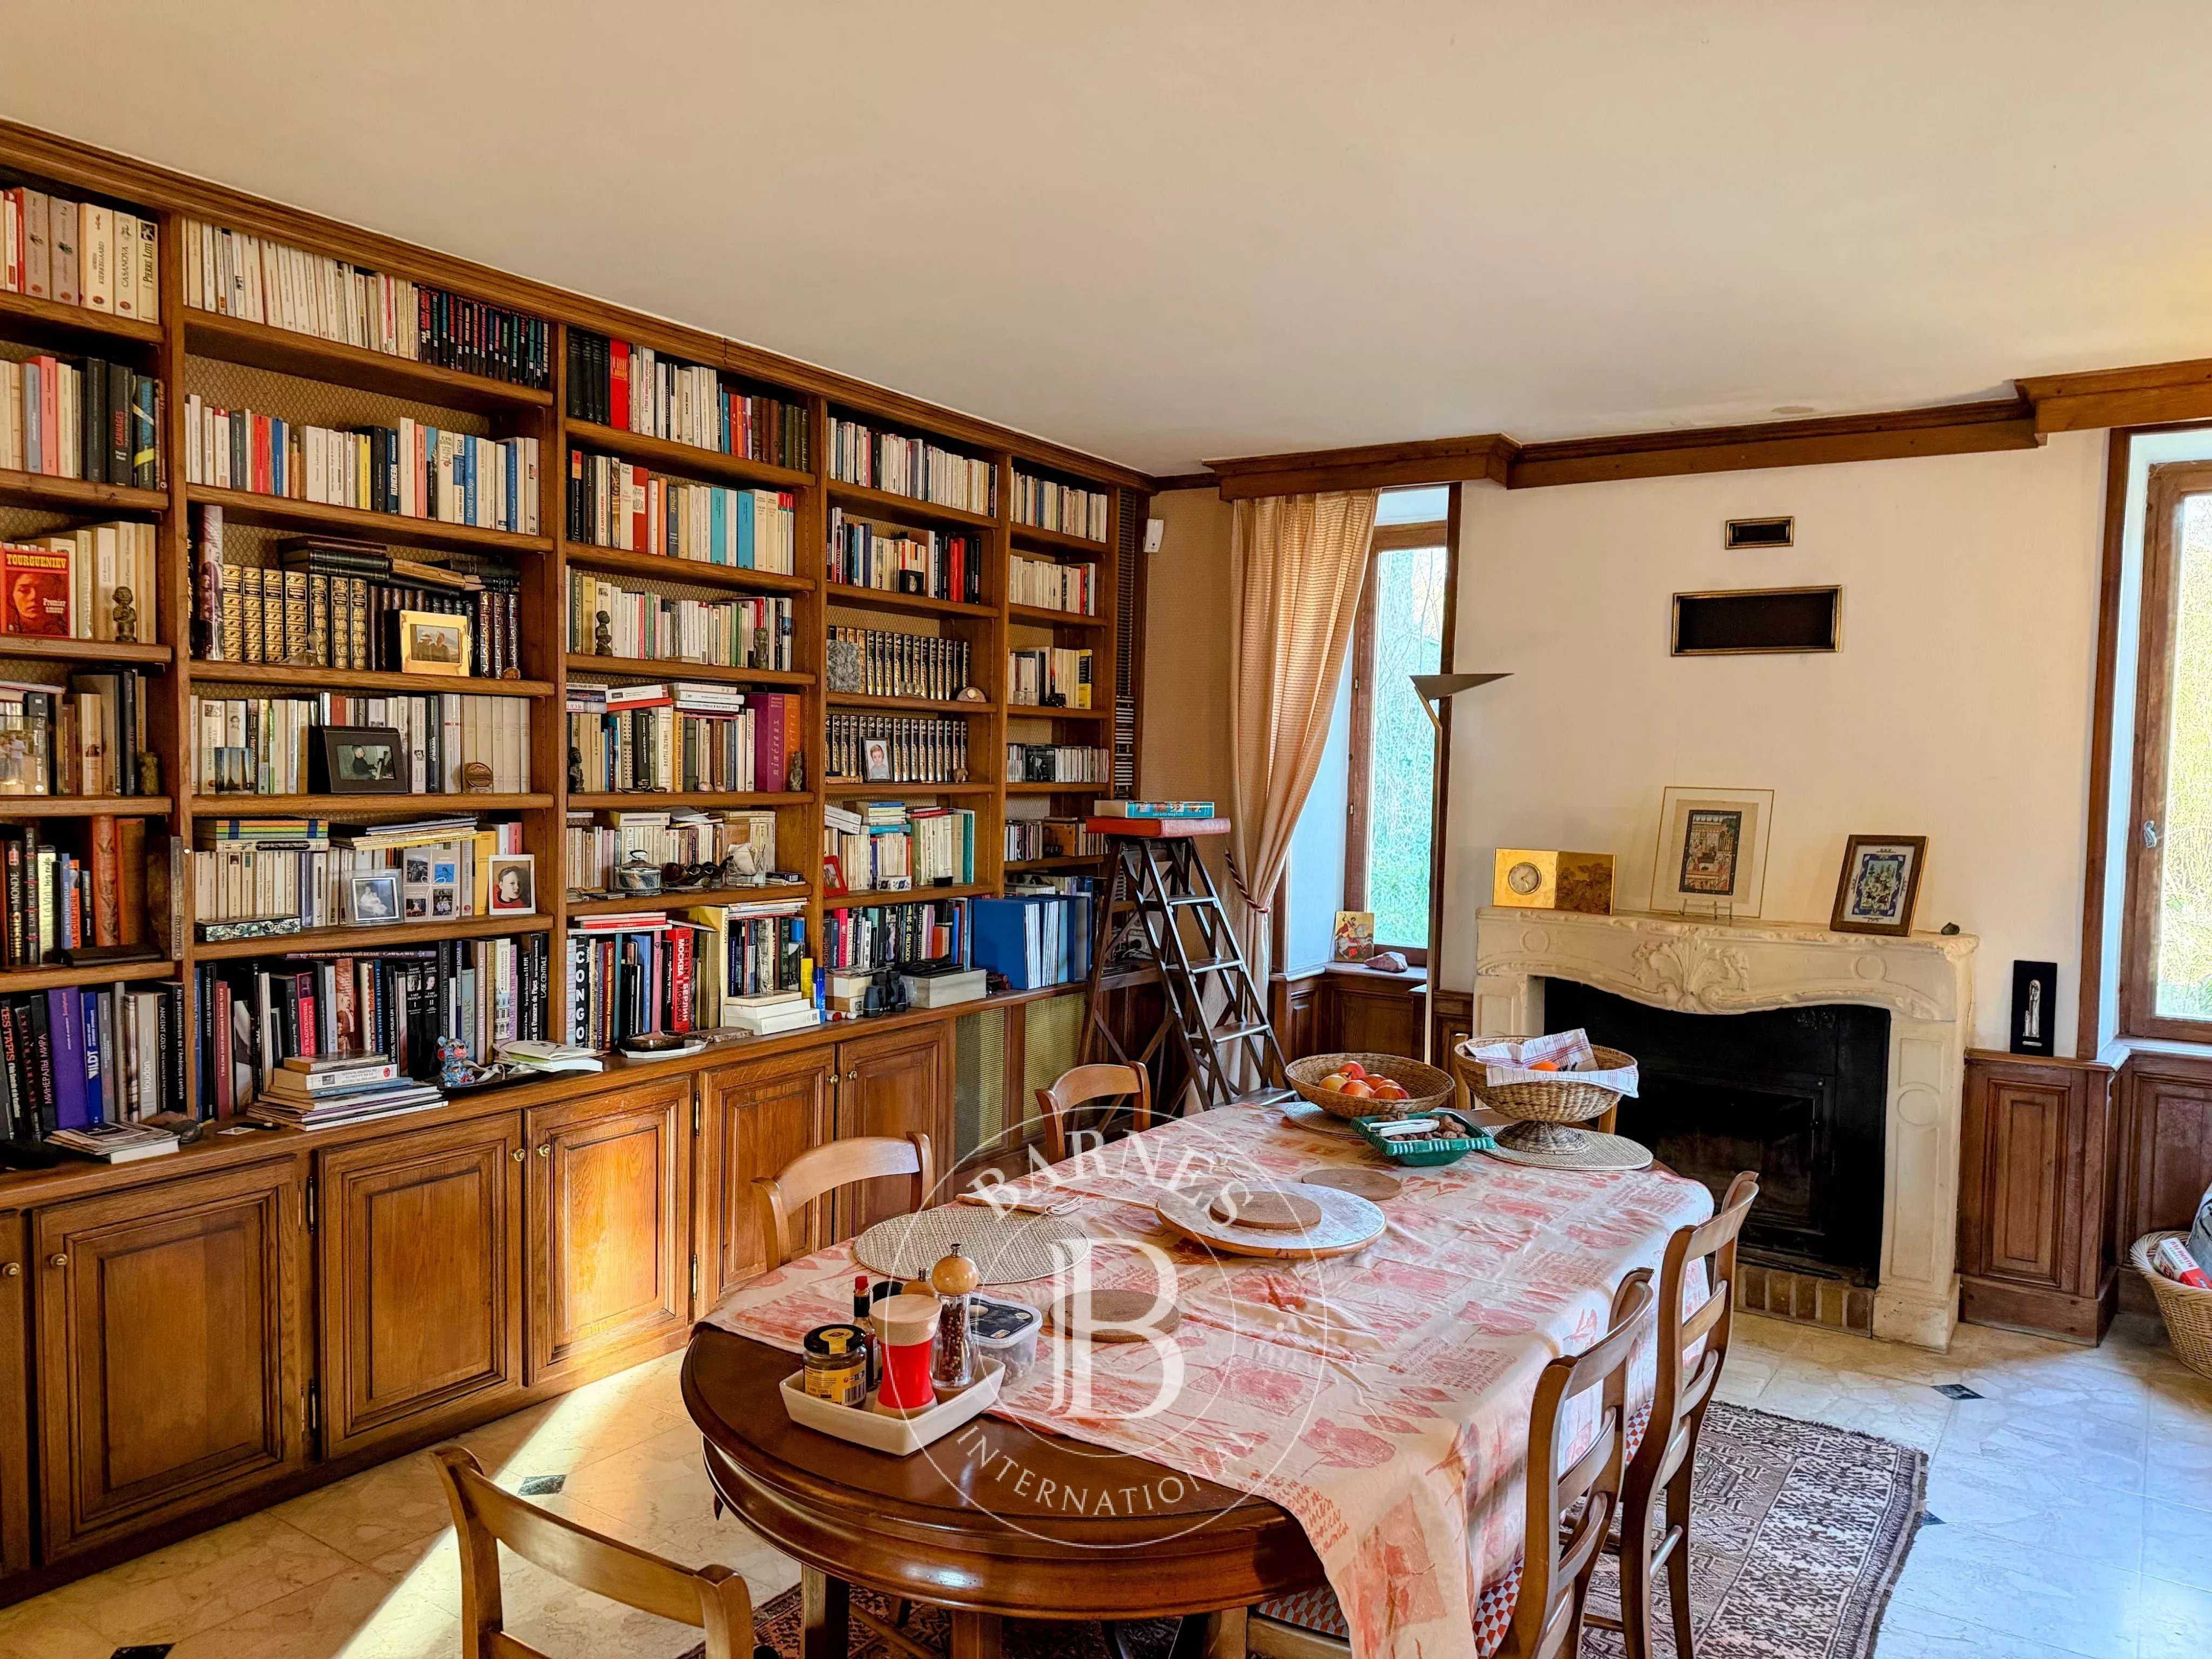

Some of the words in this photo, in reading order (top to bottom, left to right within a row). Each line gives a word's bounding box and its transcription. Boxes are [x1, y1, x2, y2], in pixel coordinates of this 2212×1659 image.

[141, 242, 153, 259] LOTI
[142, 259, 154, 283] PIERRE
[114, 410, 124, 446] CARNAGES
[390, 463, 399, 496] KUNDERA
[6, 553, 67, 569] TOURGUENIEV
[771, 719, 780, 776] minéraux
[10, 872, 19, 905] MONDE
[27, 891, 35, 900] LA
[27, 900, 35, 908] DE
[27, 909, 36, 927] L'ART
[71, 936, 78, 945] LA
[531, 980, 539, 994] Pipes
[576, 950, 585, 1040] CONGO
[1, 1006, 11, 1028] LES
[389, 1009, 396, 1017] UN
[463, 998, 472, 1041] AGUAR
[531, 1003, 539, 1026] Fumeurs
[3, 1028, 15, 1061] TAPIS
[38, 1033, 48, 1057] МИРА
[86, 1050, 99, 1080] WILDT
[142, 1061, 152, 1092] Houdon
[42, 1058, 53, 1104] МИНЕРАЛЫ
